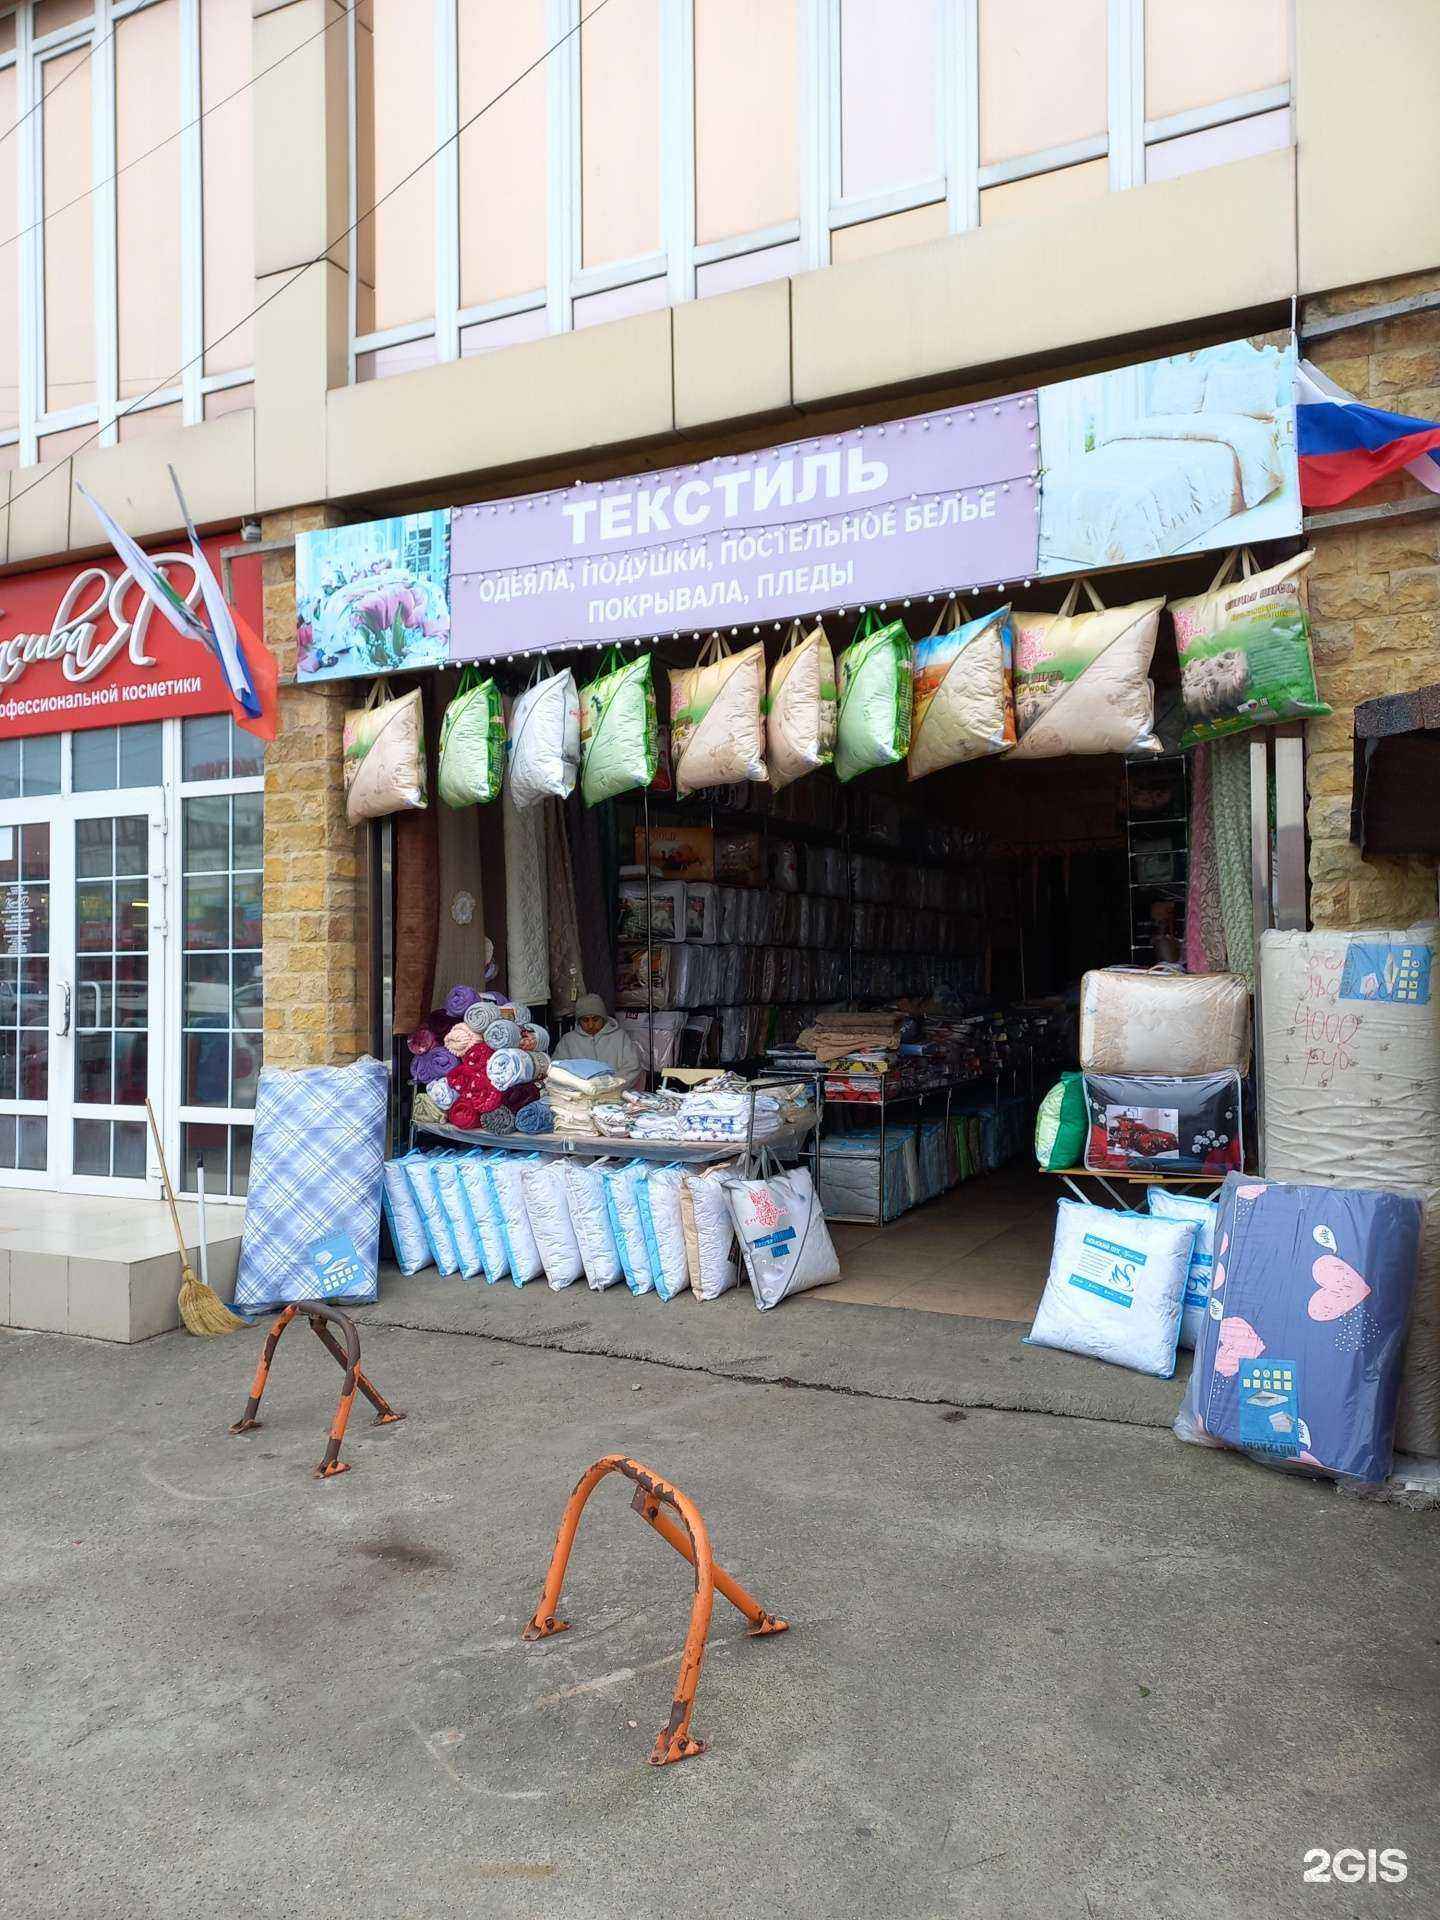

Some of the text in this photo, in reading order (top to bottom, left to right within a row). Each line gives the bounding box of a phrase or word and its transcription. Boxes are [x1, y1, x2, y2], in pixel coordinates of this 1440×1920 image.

[562, 447, 890, 544] ТЕКСТИЛЬ
[479, 491, 997, 605] ОДЕЯЛА, ПОДУШКИ, ПОСТЕЛЬНОЕ БЕЛЬЕ
[588, 560, 854, 625] ПОКРЫВАЛА, ПЛЕДЫ
[122, 677, 201, 700] косметики
